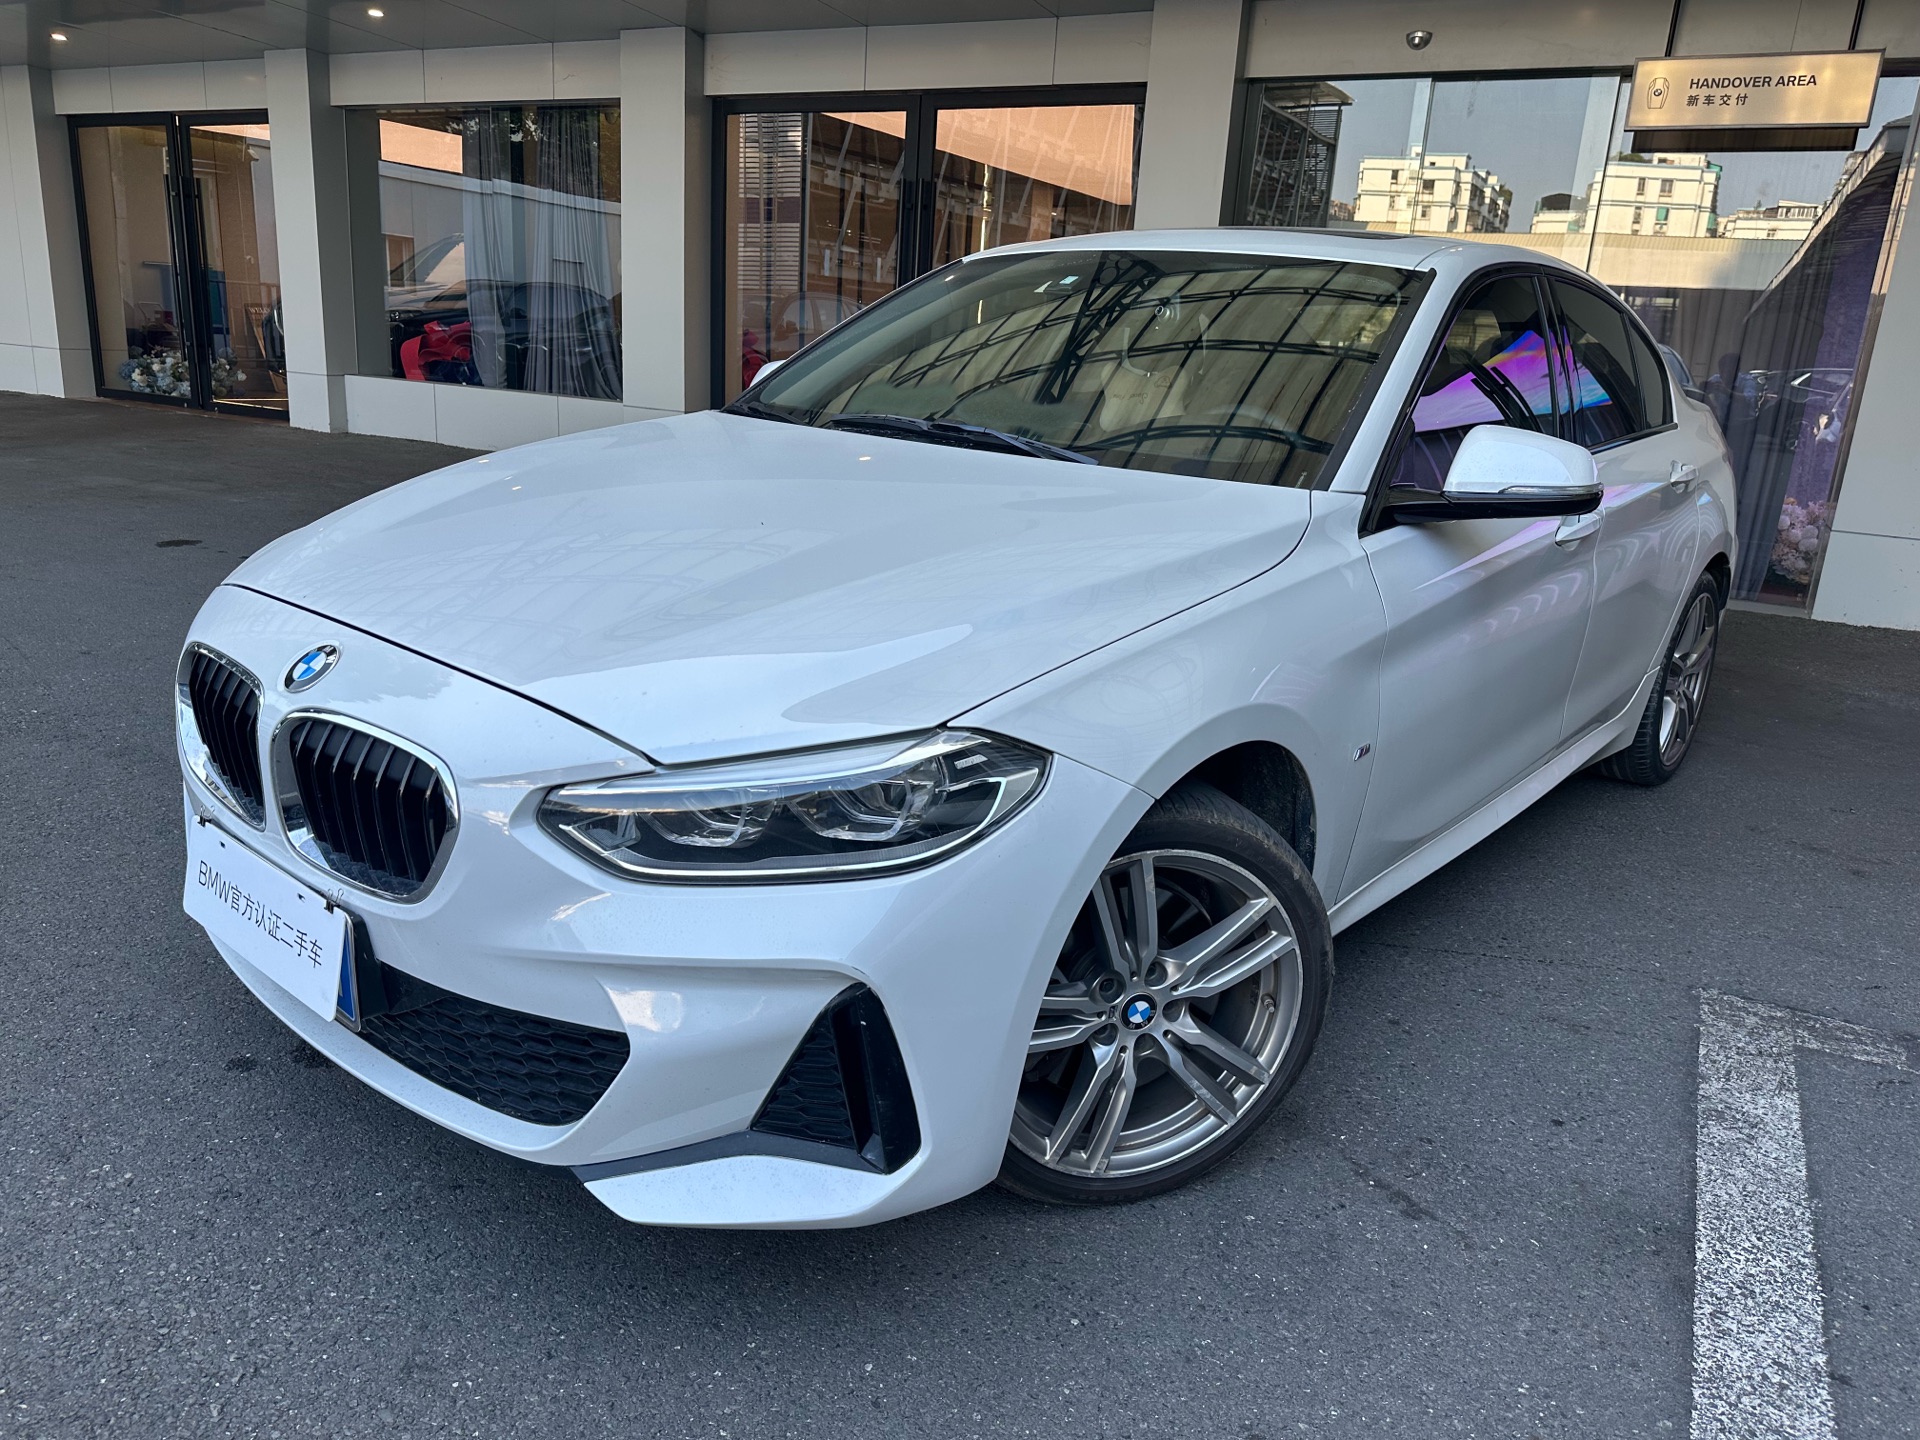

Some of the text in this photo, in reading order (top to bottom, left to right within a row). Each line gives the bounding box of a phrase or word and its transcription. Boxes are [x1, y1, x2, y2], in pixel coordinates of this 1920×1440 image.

[1689, 75, 1817, 89] HANDOVER AREA
[1686, 93, 1748, 106] 新车交付
[198, 860, 323, 968] BMW官方认证二手车
